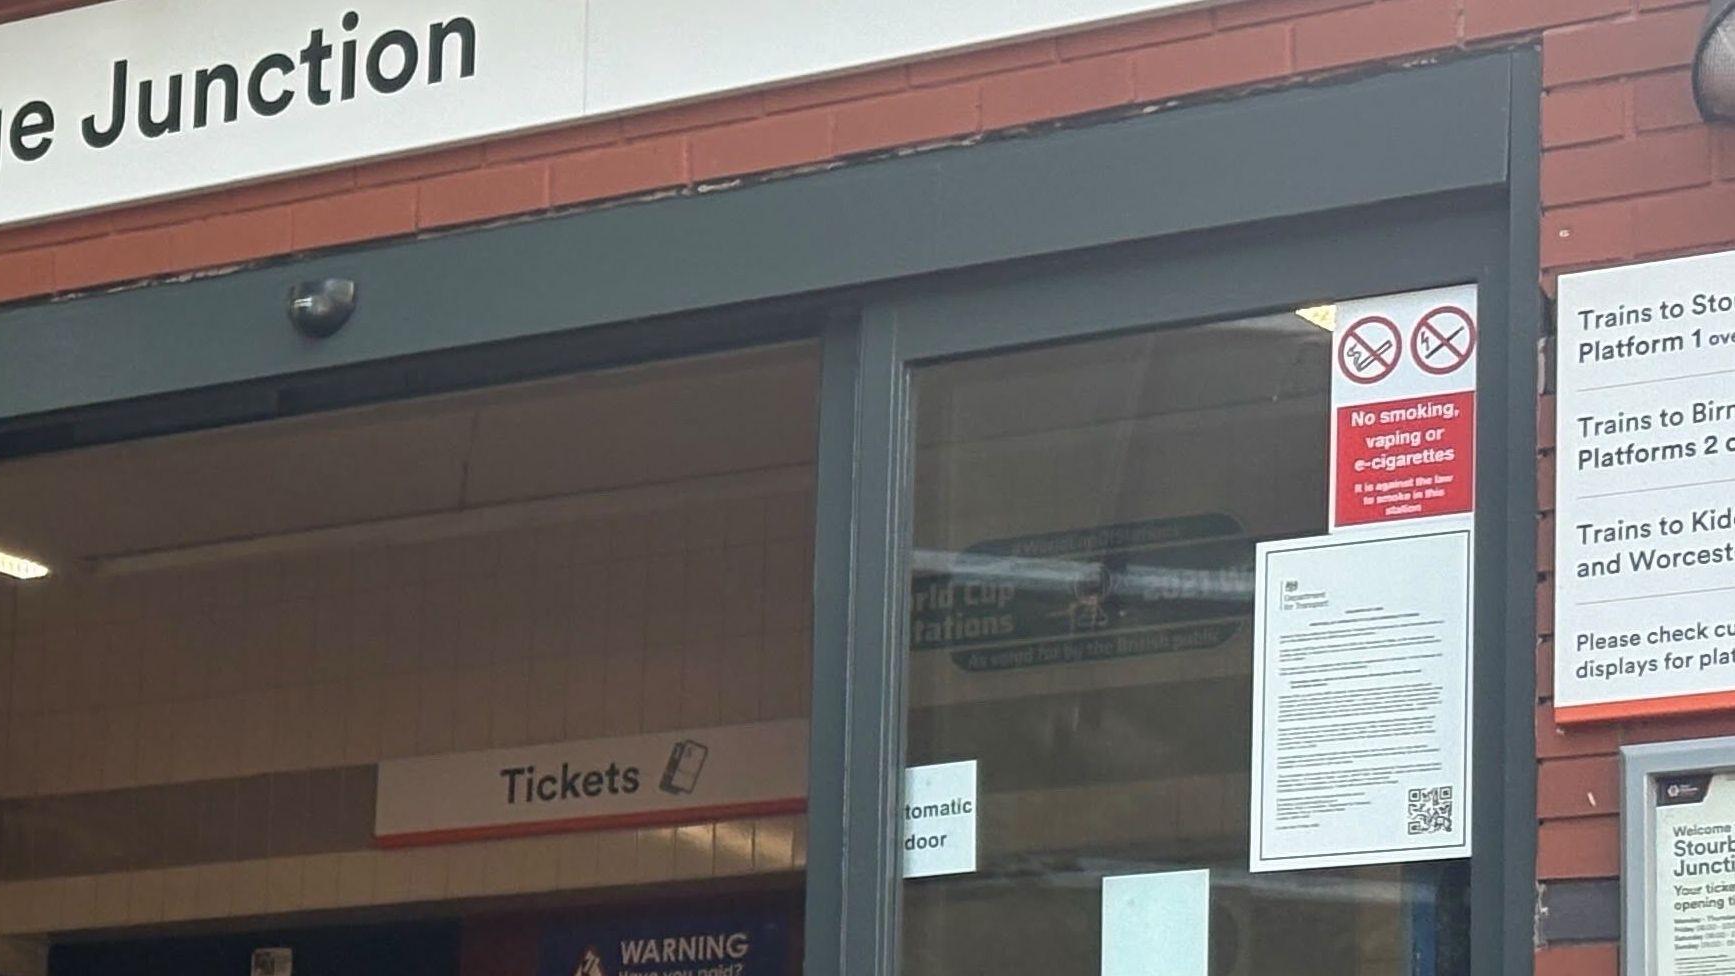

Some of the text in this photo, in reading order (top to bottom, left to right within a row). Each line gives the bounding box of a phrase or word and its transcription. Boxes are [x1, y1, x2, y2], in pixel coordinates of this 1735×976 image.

[80, 10, 477, 149] Junction
[1578, 294, 1735, 331] Trains to Sto
[1579, 335, 1684, 363] Platform
[1692, 329, 1701, 348] 1
[1351, 402, 1460, 427] No smoking,
[1577, 412, 1652, 438] Trains
[1659, 409, 1684, 428] to
[1366, 428, 1445, 450] vaping or
[1579, 442, 1696, 470] Platforms
[1704, 436, 1719, 455] 2
[1354, 448, 1455, 471] e-cigarettes
[1576, 507, 1735, 545] Trains to Kid
[1577, 543, 1735, 578] and Worcest
[916, 580, 953, 611] rld
[914, 612, 1016, 644] tations
[1577, 632, 1641, 652] Please
[1647, 622, 1708, 645] check
[1576, 657, 1658, 680] displays
[1664, 652, 1693, 670] for
[500, 761, 640, 804] Tickets
[905, 797, 973, 820] tomatic
[905, 834, 947, 850] door
[1673, 824, 1731, 837] Welcome
[1674, 885, 1702, 897] Your
[1674, 896, 1725, 912] opening
[620, 932, 749, 965] WARNING
